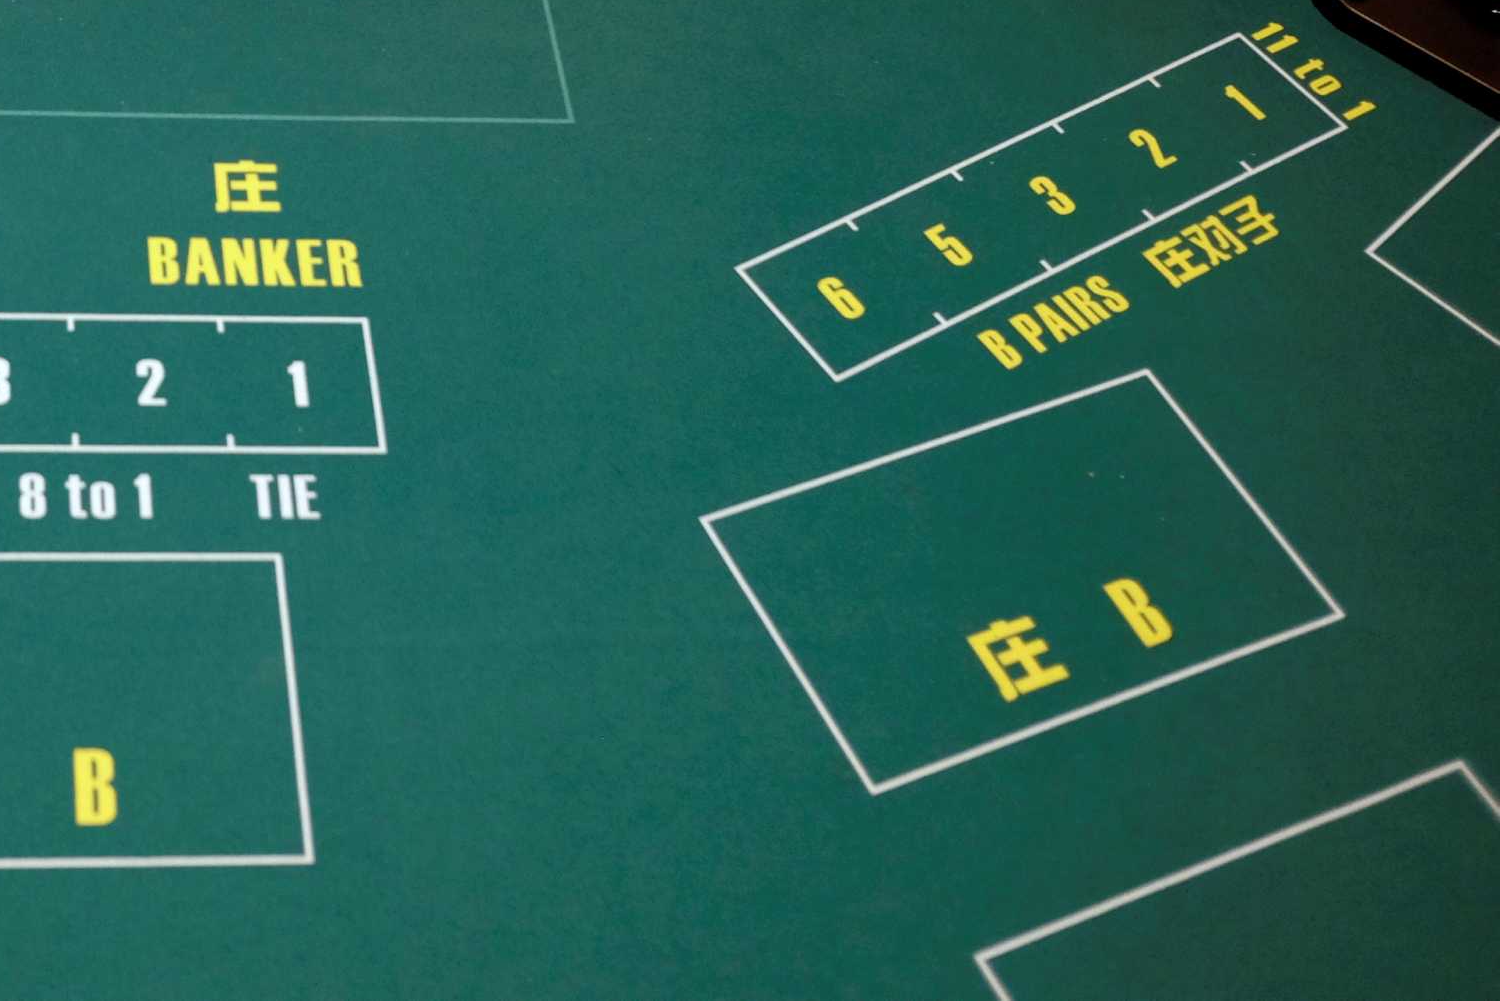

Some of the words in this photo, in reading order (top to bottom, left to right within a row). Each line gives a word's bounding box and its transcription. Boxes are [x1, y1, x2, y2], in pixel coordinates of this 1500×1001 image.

[1251, 22, 1300, 54] 11
[1293, 56, 1344, 97] to
[1342, 98, 1377, 121] 1
[213, 159, 283, 213] 庄
[816, 275, 867, 321] 6
[923, 223, 974, 267] 5
[1028, 175, 1077, 216] 3
[1128, 128, 1178, 169] 2
[1224, 85, 1267, 121] 1
[146, 235, 364, 288] BANKER
[976, 328, 1023, 371] B
[1008, 273, 1131, 354] PAIRS
[1142, 193, 1282, 289] 庄对子
[135, 358, 167, 407] 2
[286, 360, 310, 408] 1
[18, 472, 48, 520] 8
[64, 473, 118, 520] to
[132, 473, 154, 520] 1
[248, 473, 322, 520] TIE
[966, 614, 1071, 703] 庄
[1102, 576, 1175, 649] B
[72, 747, 119, 827] B
